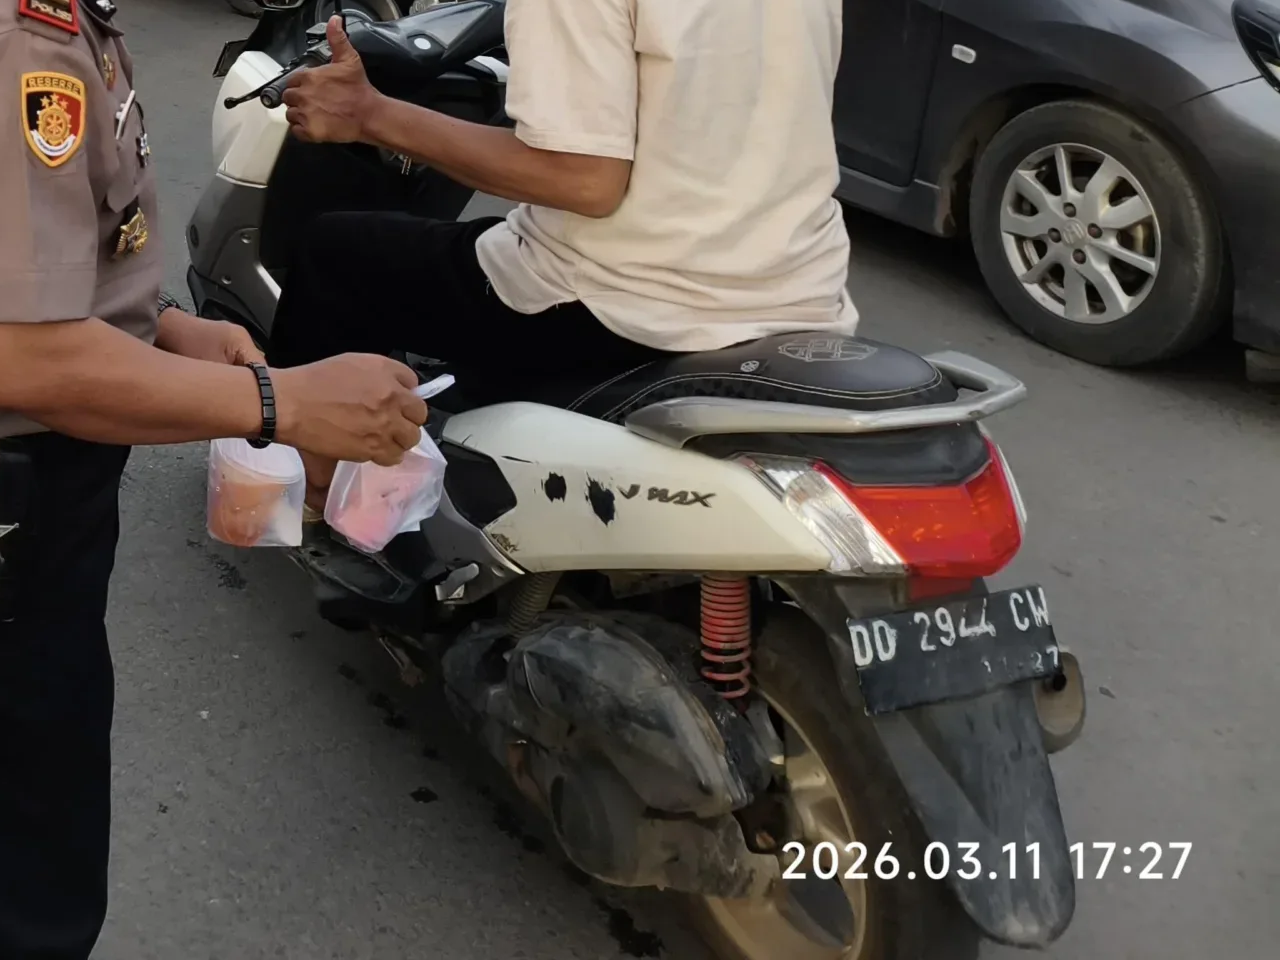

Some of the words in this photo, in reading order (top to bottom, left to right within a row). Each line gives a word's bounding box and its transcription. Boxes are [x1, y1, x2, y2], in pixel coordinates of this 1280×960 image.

[28, 77, 81, 95] RESERSE
[849, 619, 898, 667] DD
[1009, 586, 1051, 632] CW
